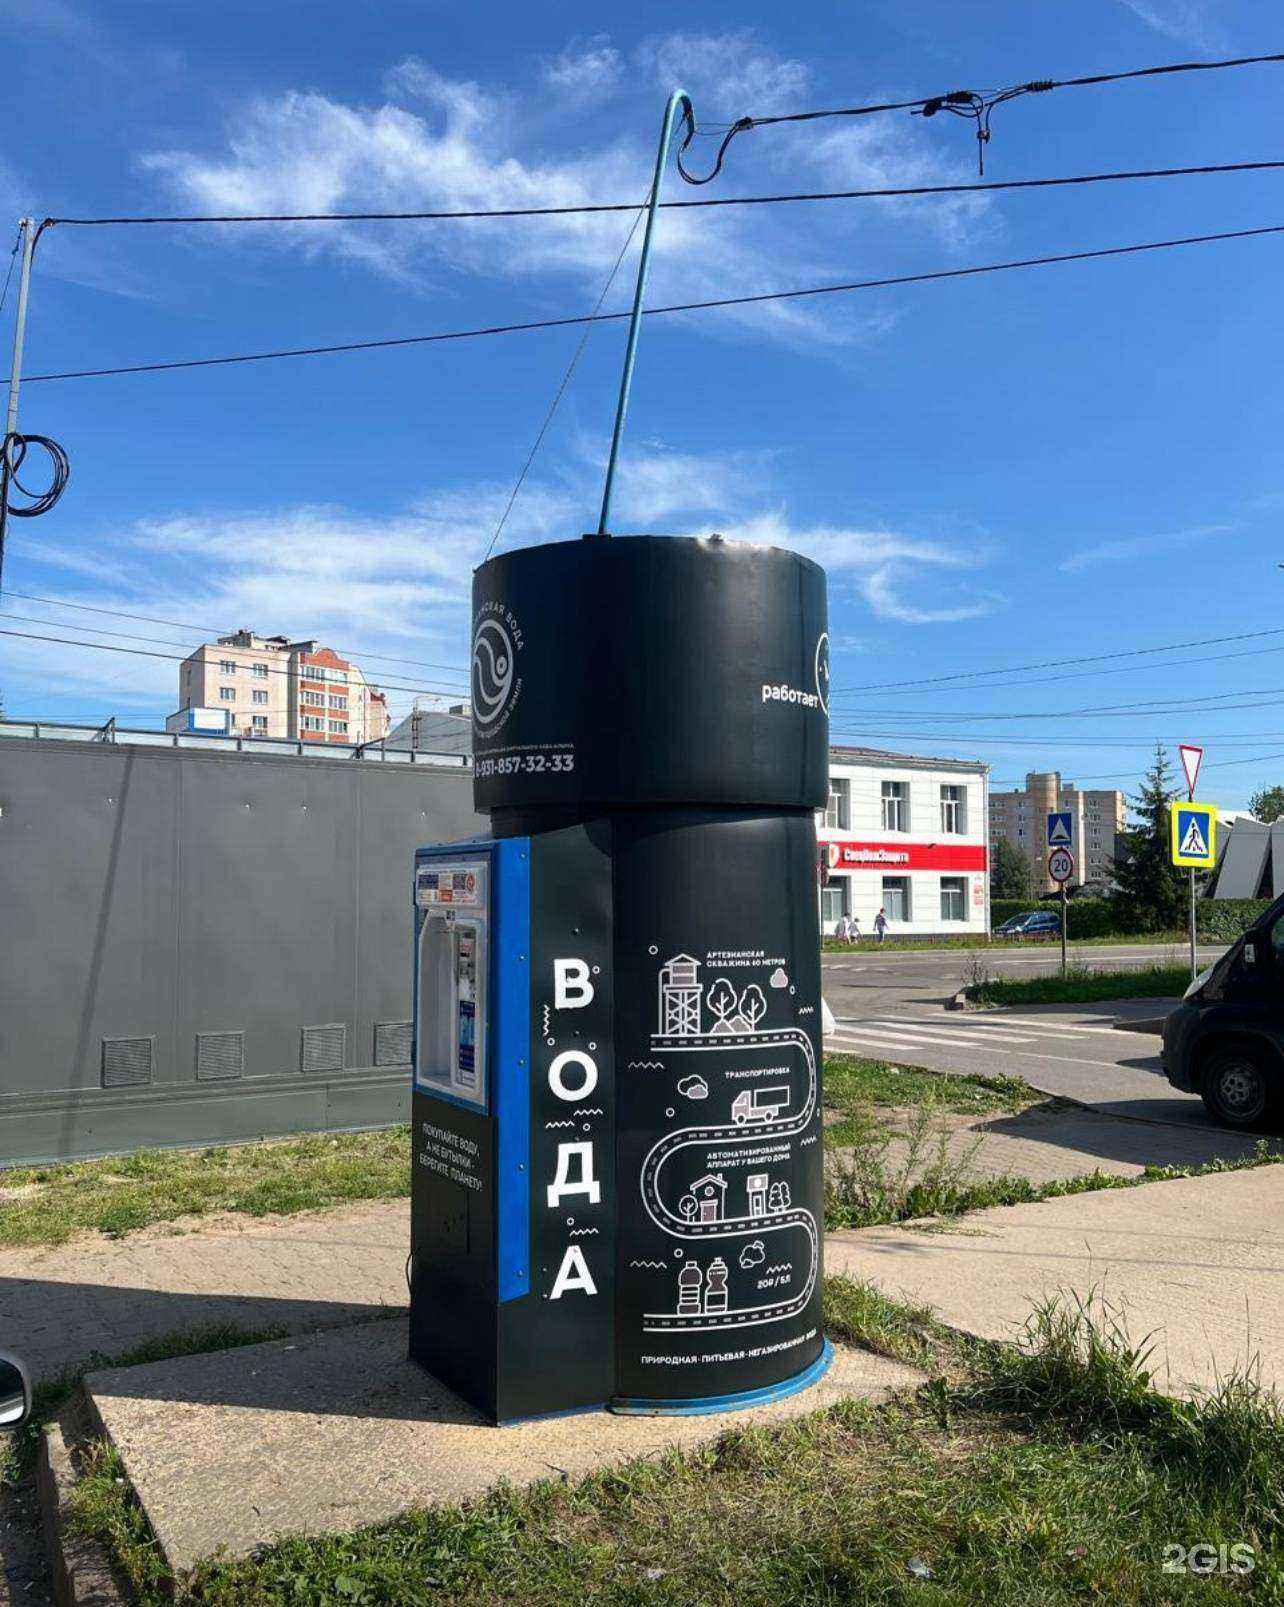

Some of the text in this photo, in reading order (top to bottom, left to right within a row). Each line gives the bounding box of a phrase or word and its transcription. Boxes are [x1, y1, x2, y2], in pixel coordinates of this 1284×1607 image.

[761, 684, 818, 707] работает
[1054, 859, 1068, 872] 20
[706, 950, 765, 959] АРТЕЗИАНСКАЯ
[706, 959, 751, 967] СКВАЖИНА
[762, 958, 786, 966] МЕТРОВ
[724, 1066, 790, 1079] ТРАНСПОРТИРОВКА
[706, 1159, 740, 1169] АППАРАТ
[746, 1155, 772, 1165] ВАШЕГО
[641, 1356, 698, 1366] ПРИРОДНАЯ
[701, 1350, 745, 1364] ПИТЬЕВАЯ
